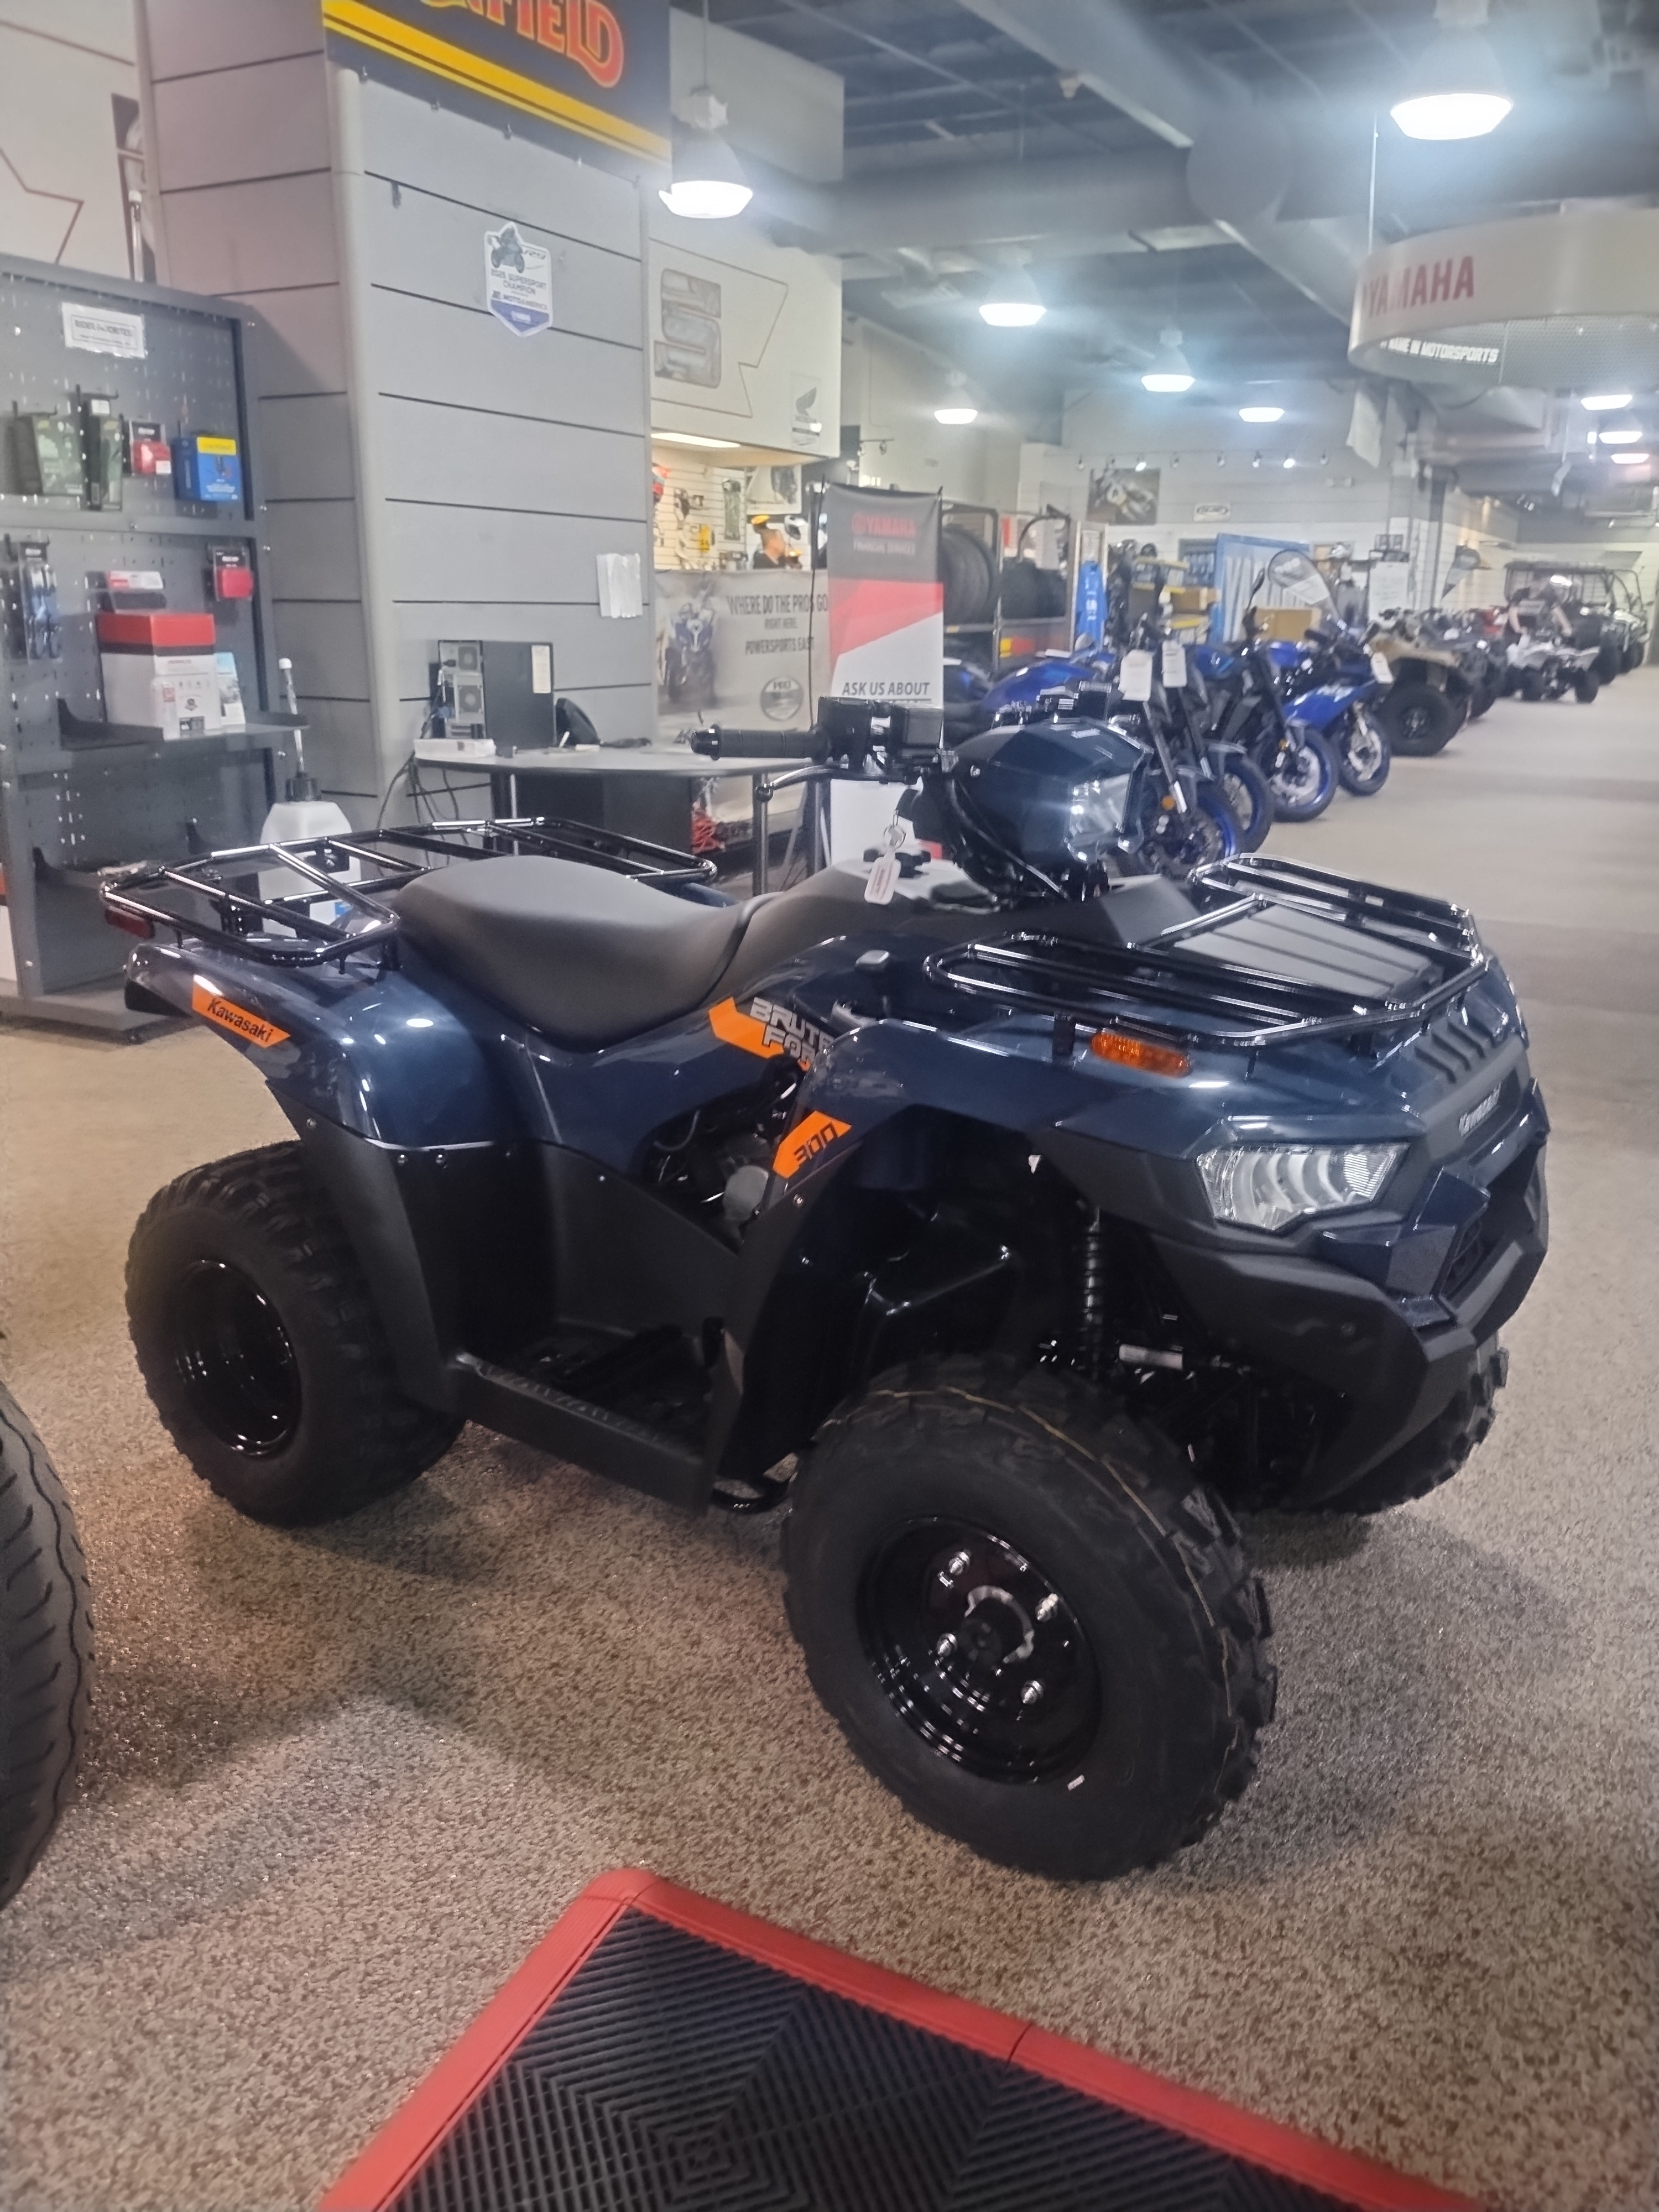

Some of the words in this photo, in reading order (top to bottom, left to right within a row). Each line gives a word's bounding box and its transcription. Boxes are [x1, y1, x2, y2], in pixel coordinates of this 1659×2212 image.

[1420, 341, 1500, 363] MOTORSPORTS
[726, 594, 761, 615] WHERE
[763, 594, 774, 614] DO
[775, 594, 791, 613] THE
[816, 593, 828, 613] GO
[745, 638, 796, 655] POWERSPORTS
[842, 682, 867, 696] ASK
[869, 682, 885, 696] US
[887, 682, 930, 696] ABOUT
[207, 998, 274, 1043] Kawasaki
[750, 997, 835, 1052] BRUTE
[793, 1123, 839, 1166] 300
